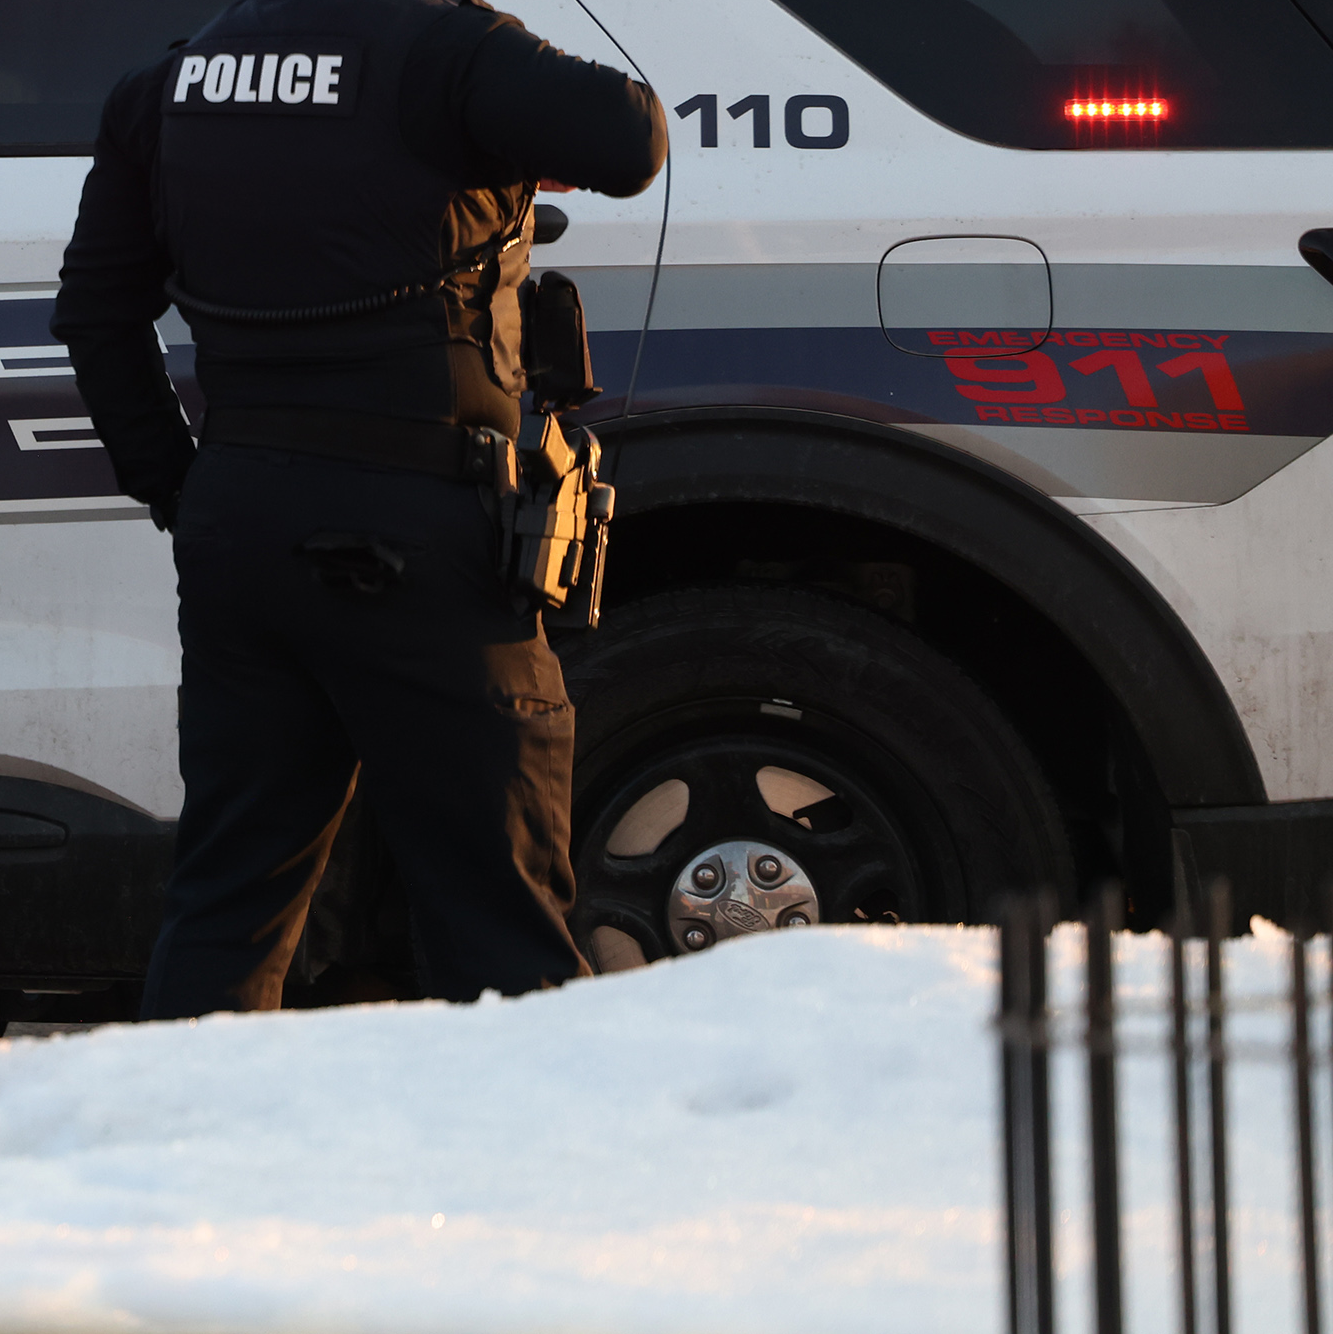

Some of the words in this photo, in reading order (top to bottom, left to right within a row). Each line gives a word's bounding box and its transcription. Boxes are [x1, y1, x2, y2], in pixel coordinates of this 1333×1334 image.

[172, 53, 342, 106] POLICE
[674, 93, 850, 150] 110
[925, 329, 1231, 351] EMERGENCY
[941, 347, 1247, 412] 911
[973, 404, 1250, 432] RESPONSE
